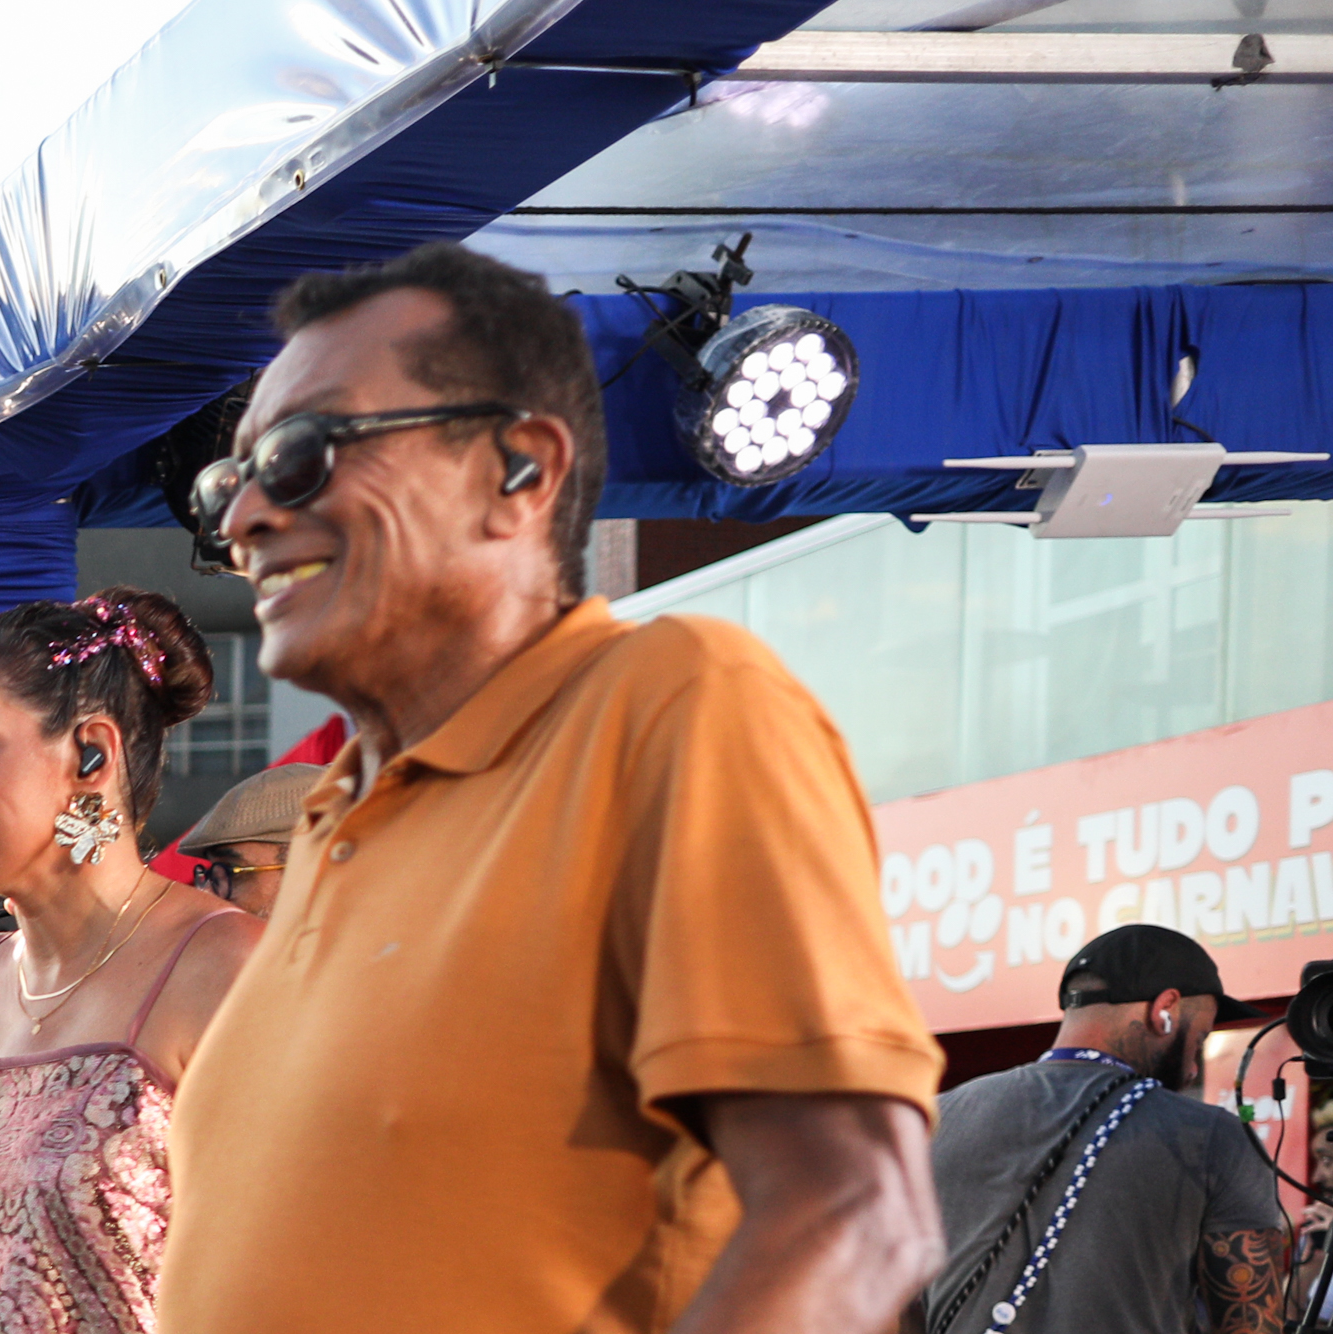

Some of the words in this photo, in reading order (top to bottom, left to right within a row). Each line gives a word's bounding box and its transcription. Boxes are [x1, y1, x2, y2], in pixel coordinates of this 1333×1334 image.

[1014, 811, 1052, 896] É
[1078, 784, 1260, 885] TUDO
[1006, 896, 1085, 968] NO
